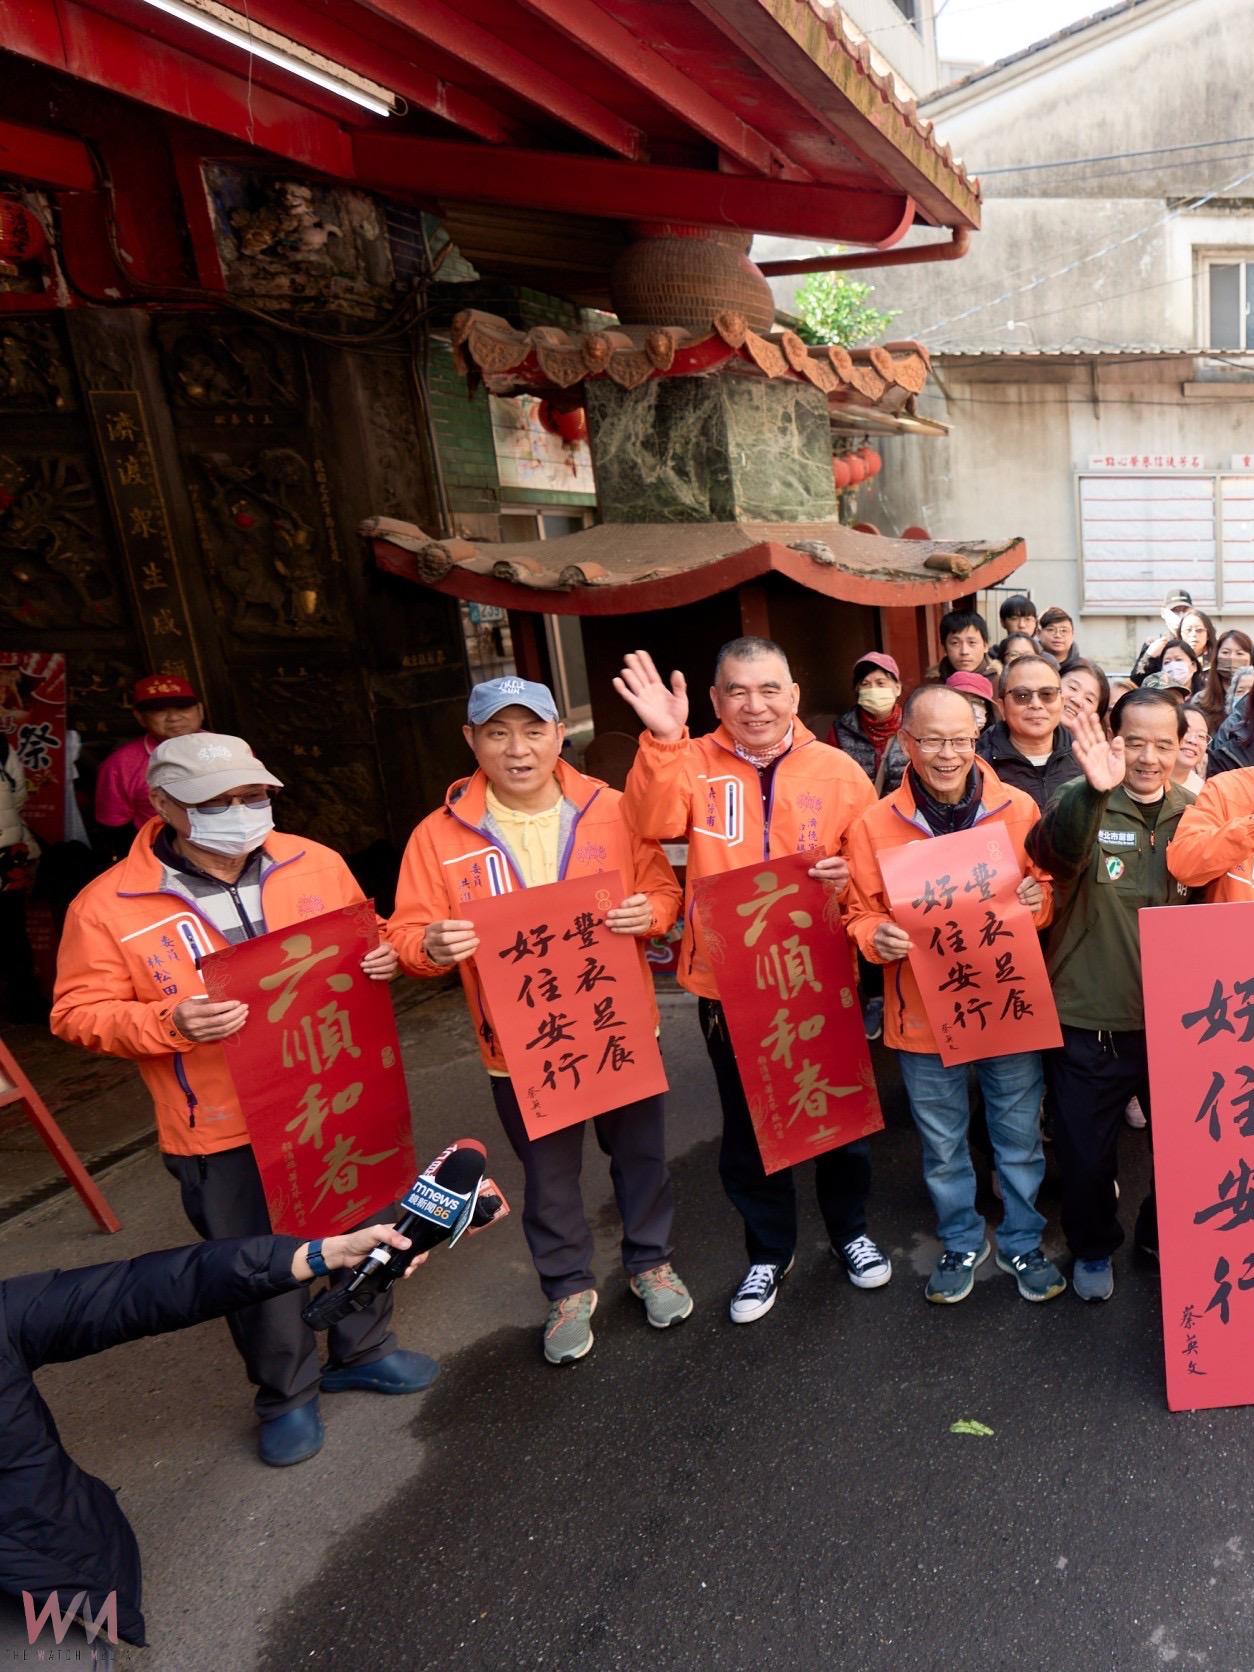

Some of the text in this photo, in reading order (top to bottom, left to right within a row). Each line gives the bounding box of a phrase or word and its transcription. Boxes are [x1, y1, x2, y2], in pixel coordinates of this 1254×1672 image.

[17, 724, 60, 770] 祭
[146, 955, 178, 996] 林松田
[498, 924, 589, 1091] 好住安行
[563, 911, 635, 1075] 豐衣足食
[736, 870, 864, 1128] 六順和春
[911, 874, 993, 1031] 好住安行
[964, 862, 1035, 1021] 豐衣足食
[259, 934, 400, 1213] 六順和春
[413, 1181, 460, 1210] mnews
[1179, 1305, 1208, 1377] 蔡英文
